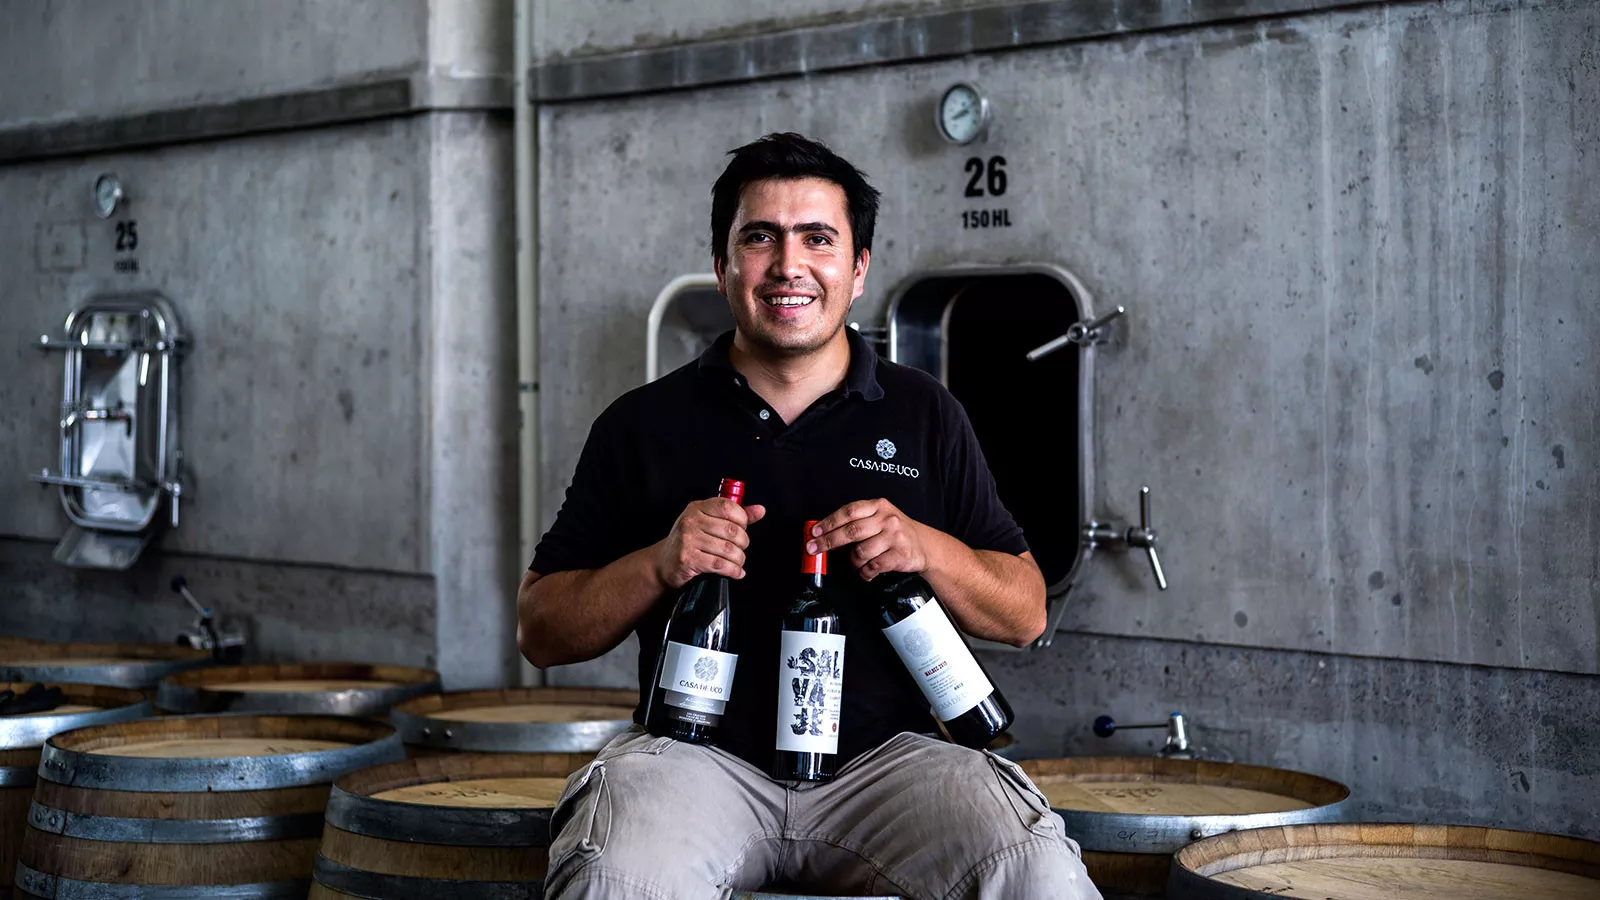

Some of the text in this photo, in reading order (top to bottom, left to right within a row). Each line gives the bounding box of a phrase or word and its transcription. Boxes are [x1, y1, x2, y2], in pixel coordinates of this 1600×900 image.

[964, 155, 1007, 198] 26
[962, 209, 1012, 229] 150 HL
[115, 220, 138, 251] 25
[679, 679, 699, 690] CASA
